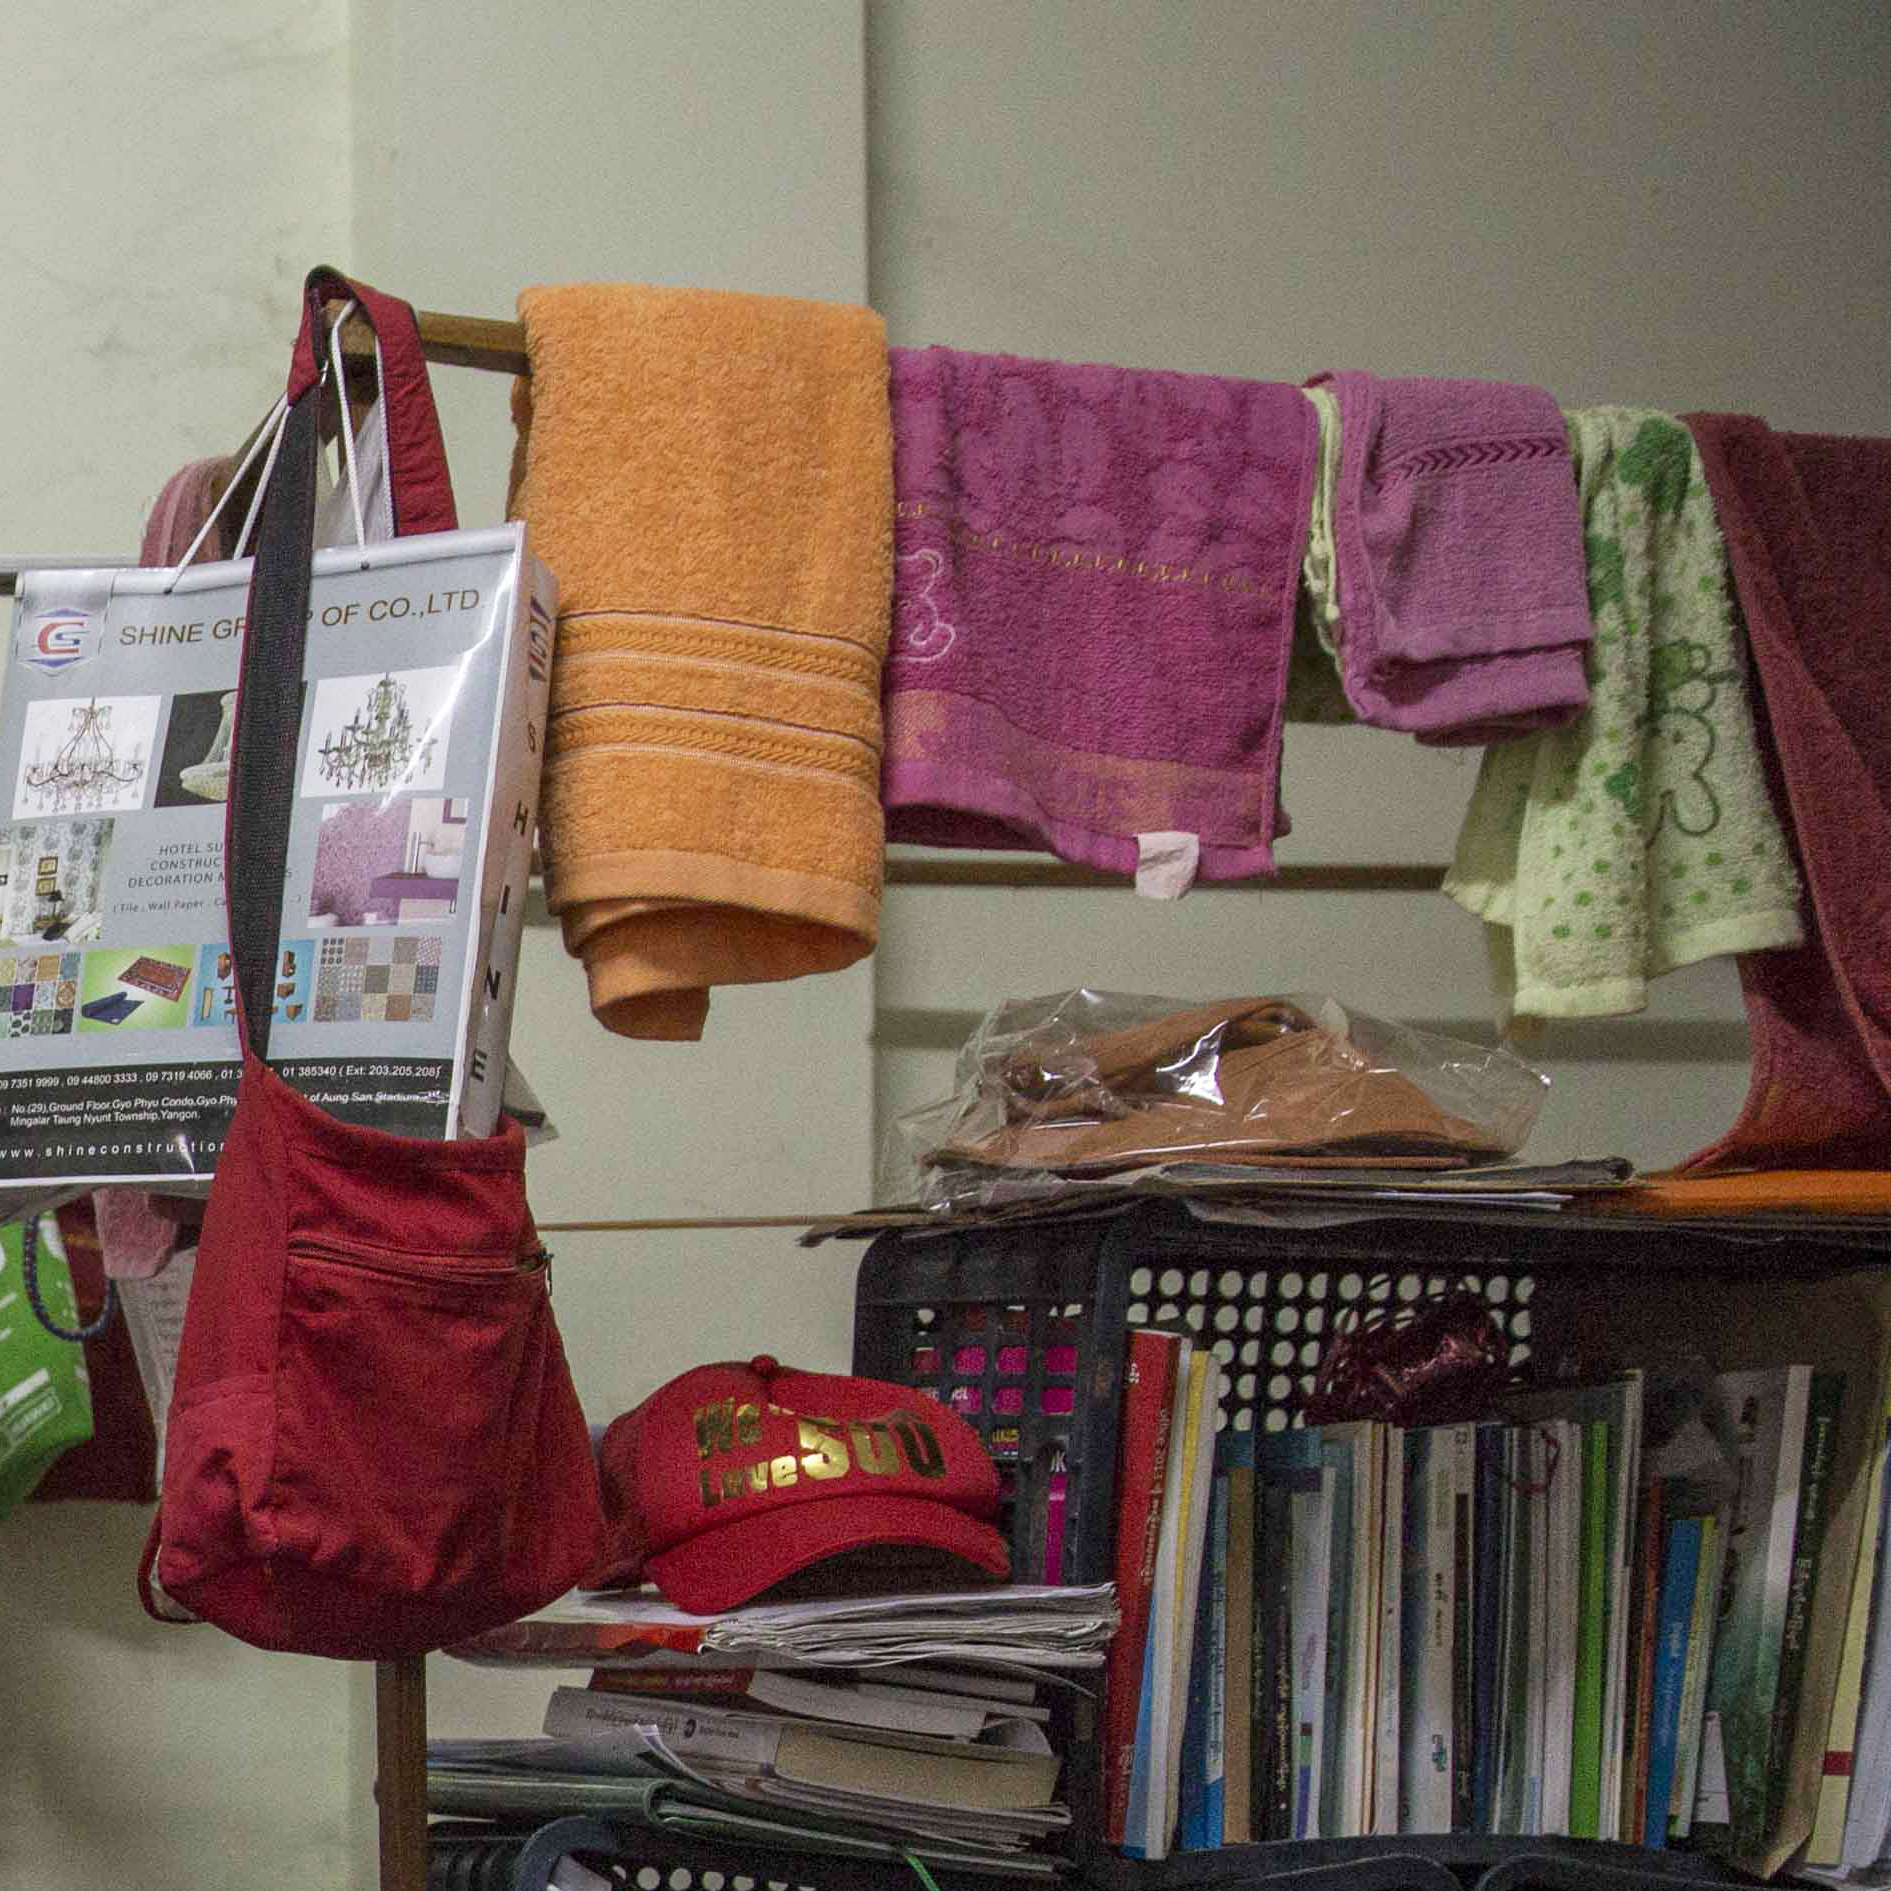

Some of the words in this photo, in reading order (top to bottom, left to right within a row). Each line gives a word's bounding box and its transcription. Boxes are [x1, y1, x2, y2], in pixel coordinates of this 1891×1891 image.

[118, 621, 204, 647] SHINE
[321, 603, 363, 627] OF
[158, 842, 201, 857] HOTEL
[149, 856, 222, 872] CONSTRUC
[128, 871, 214, 889] DECORATION
[10, 1078, 34, 1090] 7351
[66, 1075, 80, 1087] 09
[145, 1071, 159, 1083] 09
[282, 1066, 296, 1078] 01
[133, 1097, 160, 1110] Phyu
[321, 1093, 349, 1104] Aung
[352, 1091, 372, 1102] San
[10, 1114, 51, 1128] Mingalar
[83, 1111, 112, 1125] Nyunt
